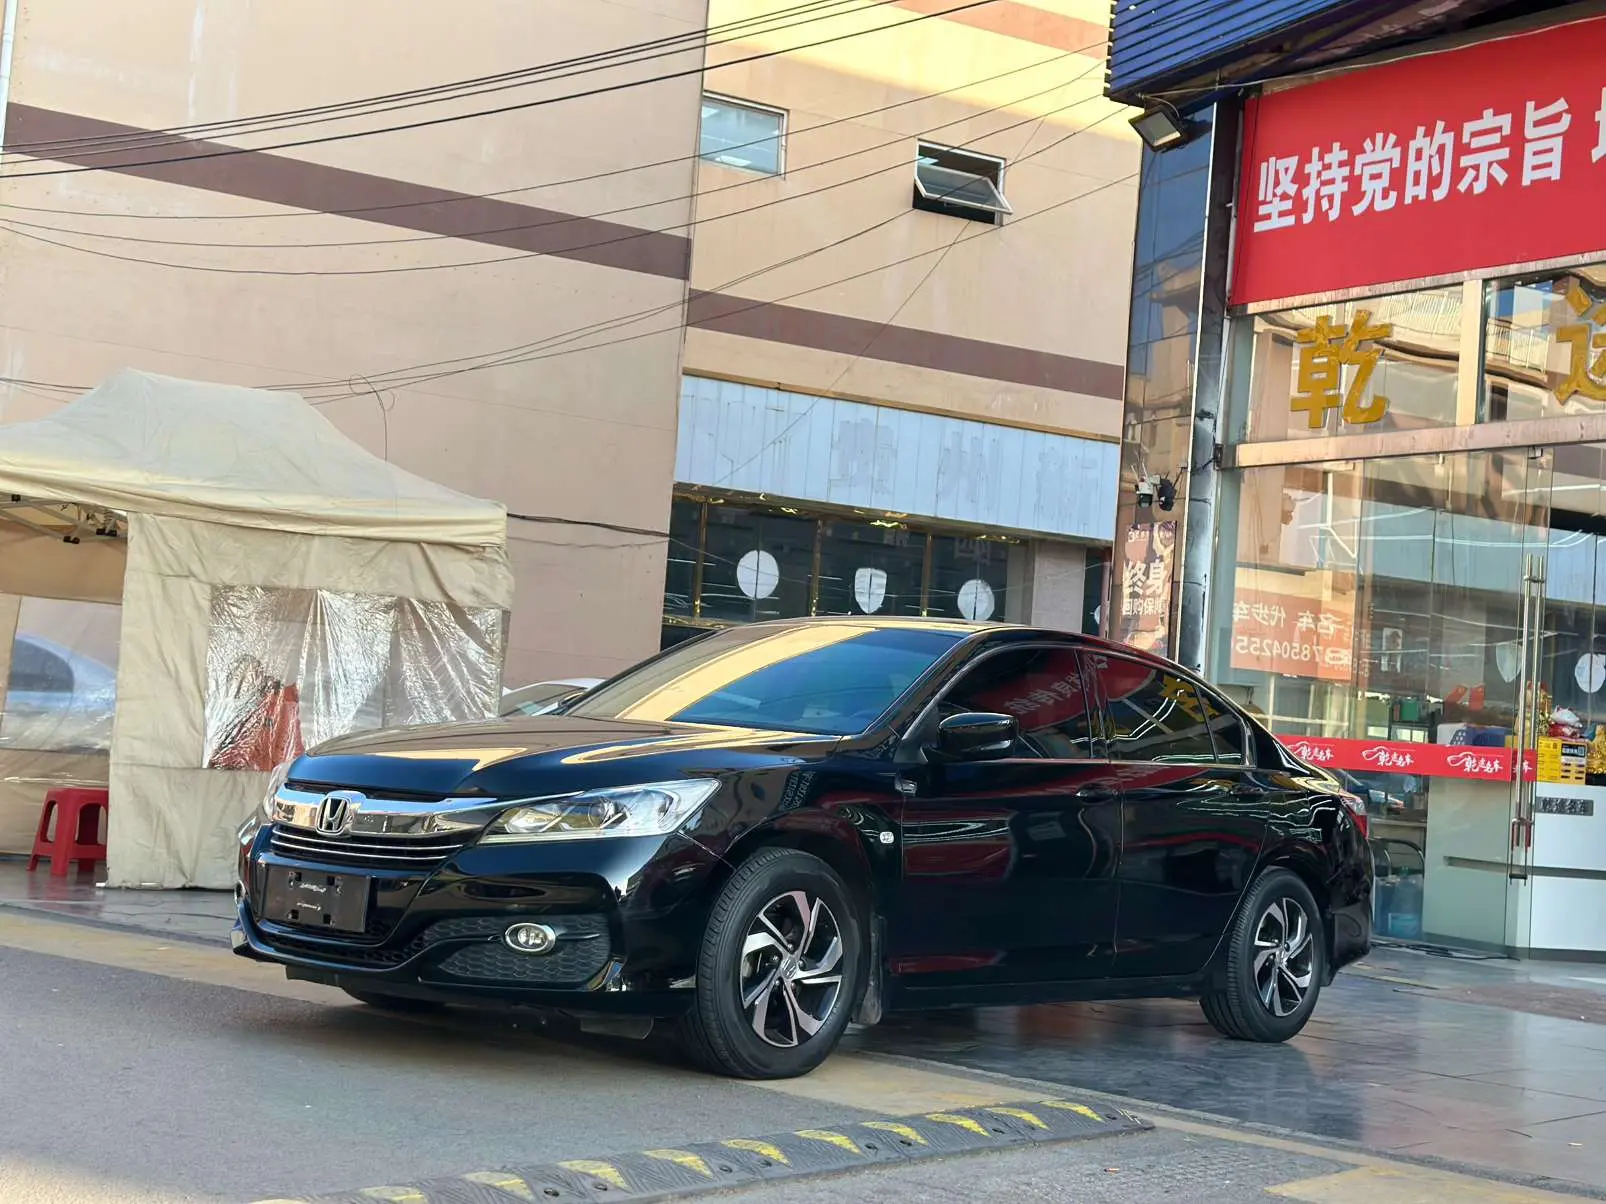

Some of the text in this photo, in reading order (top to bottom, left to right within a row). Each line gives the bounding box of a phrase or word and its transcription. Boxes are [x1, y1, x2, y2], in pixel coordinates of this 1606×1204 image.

[1254, 97, 1571, 232] 坚持党的宗旨
